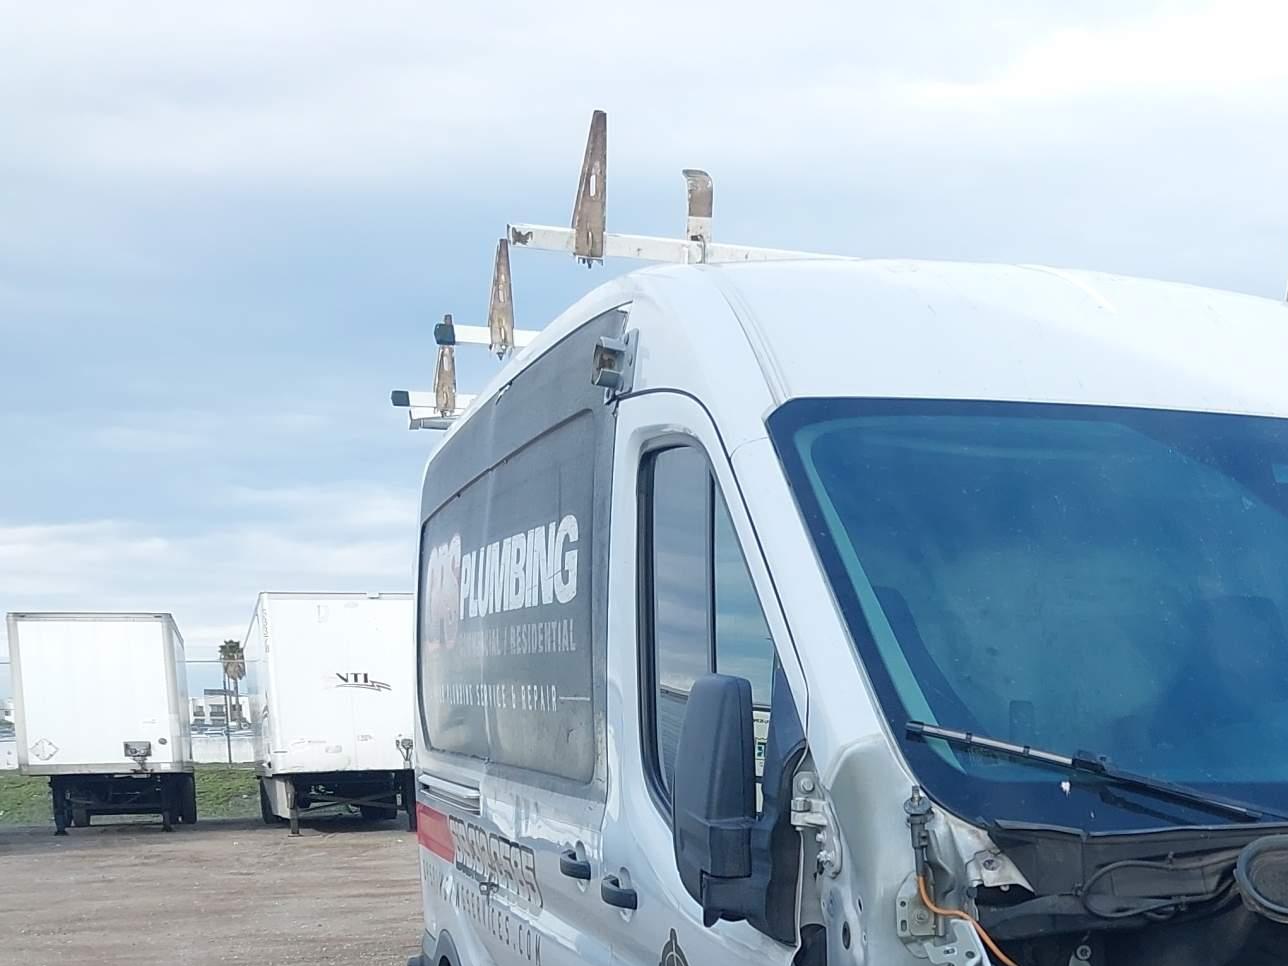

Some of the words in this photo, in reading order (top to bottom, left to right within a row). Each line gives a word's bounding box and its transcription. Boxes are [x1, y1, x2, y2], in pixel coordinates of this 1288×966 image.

[460, 514, 579, 621] PLUMBING
[510, 618, 576, 655] RESIDENTIAL
[335, 672, 369, 684] VTI
[521, 685, 557, 712] REPAIR
